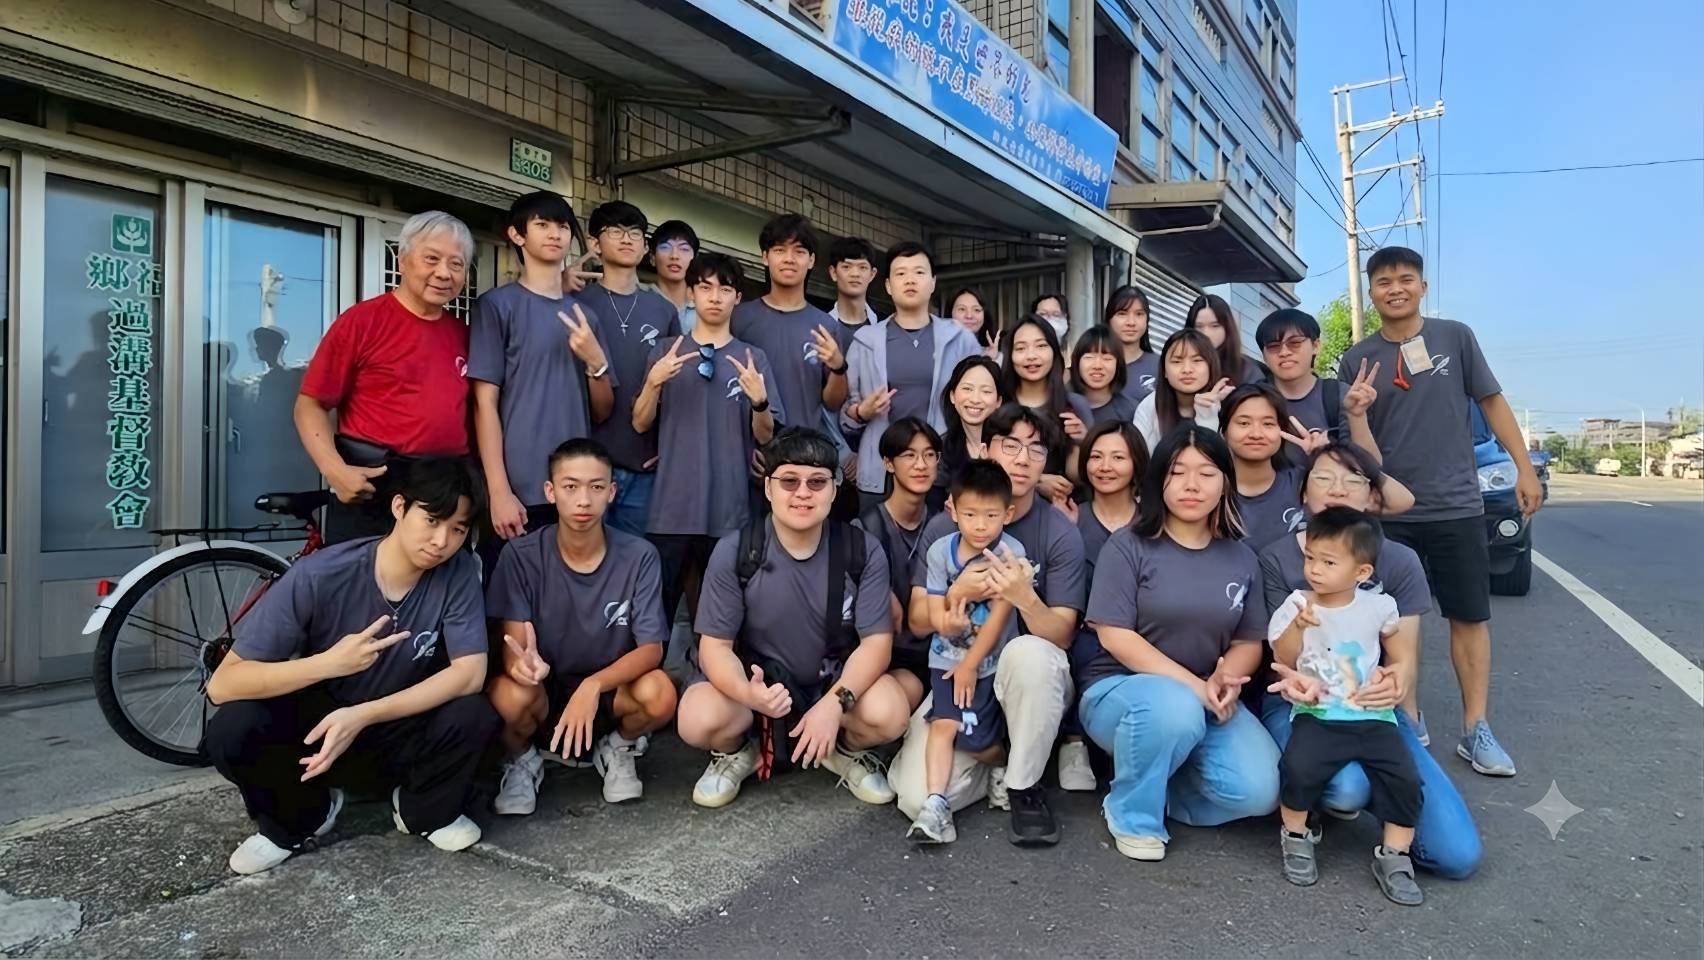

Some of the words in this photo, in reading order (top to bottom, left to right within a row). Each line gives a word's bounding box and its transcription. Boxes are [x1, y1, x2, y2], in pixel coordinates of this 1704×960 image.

[106, 297, 153, 529] 過溝基督教會
